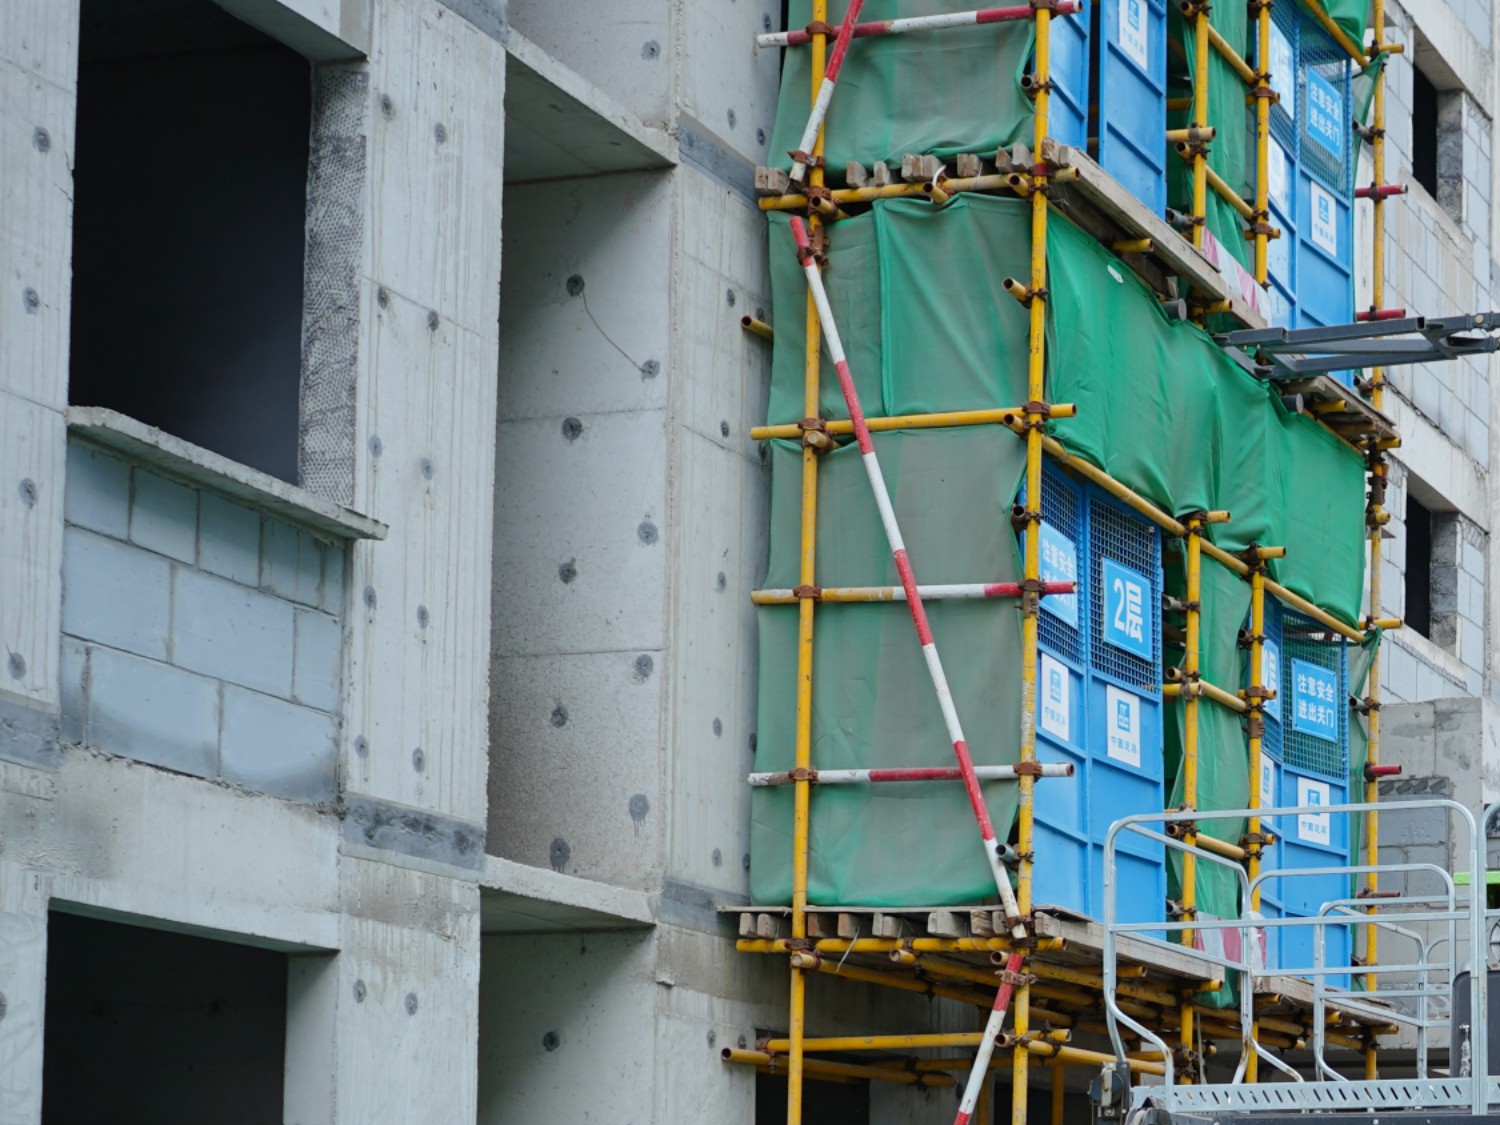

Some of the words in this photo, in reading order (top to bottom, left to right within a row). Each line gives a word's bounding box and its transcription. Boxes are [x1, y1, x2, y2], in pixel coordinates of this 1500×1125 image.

[1042, 538, 1074, 578] 注意安全
[1113, 577, 1143, 644] 2层
[1297, 673, 1334, 702] 注意安全
[1298, 699, 1334, 728] 进出关门
